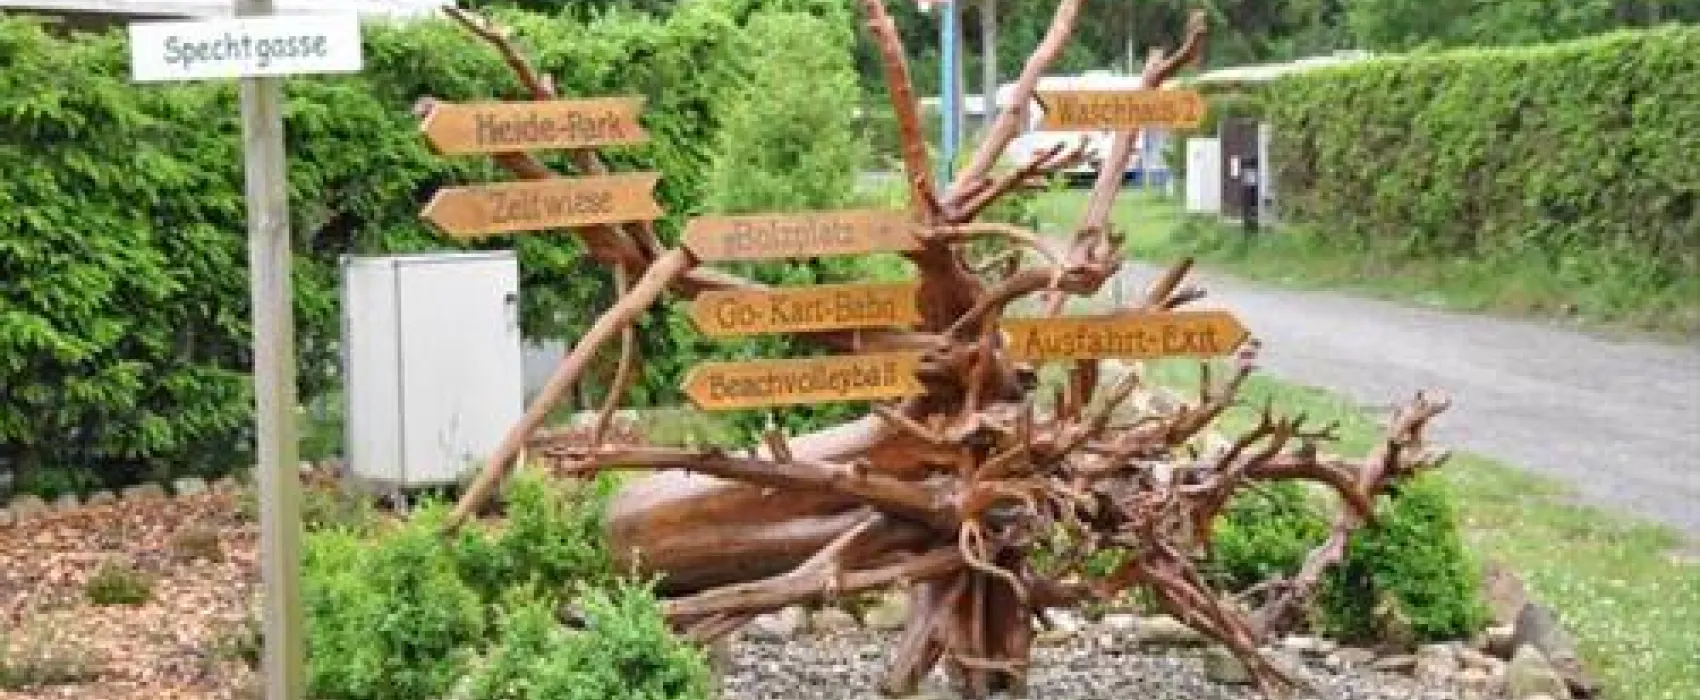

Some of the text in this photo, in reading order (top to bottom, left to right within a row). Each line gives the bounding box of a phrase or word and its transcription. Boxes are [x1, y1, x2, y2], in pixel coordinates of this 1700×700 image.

[162, 34, 328, 66] Spechtgasse
[1056, 94, 1199, 124] Waschhaus 2
[474, 109, 627, 147] Heide-Park
[1025, 325, 1219, 355] Ausfahrt-Exit
